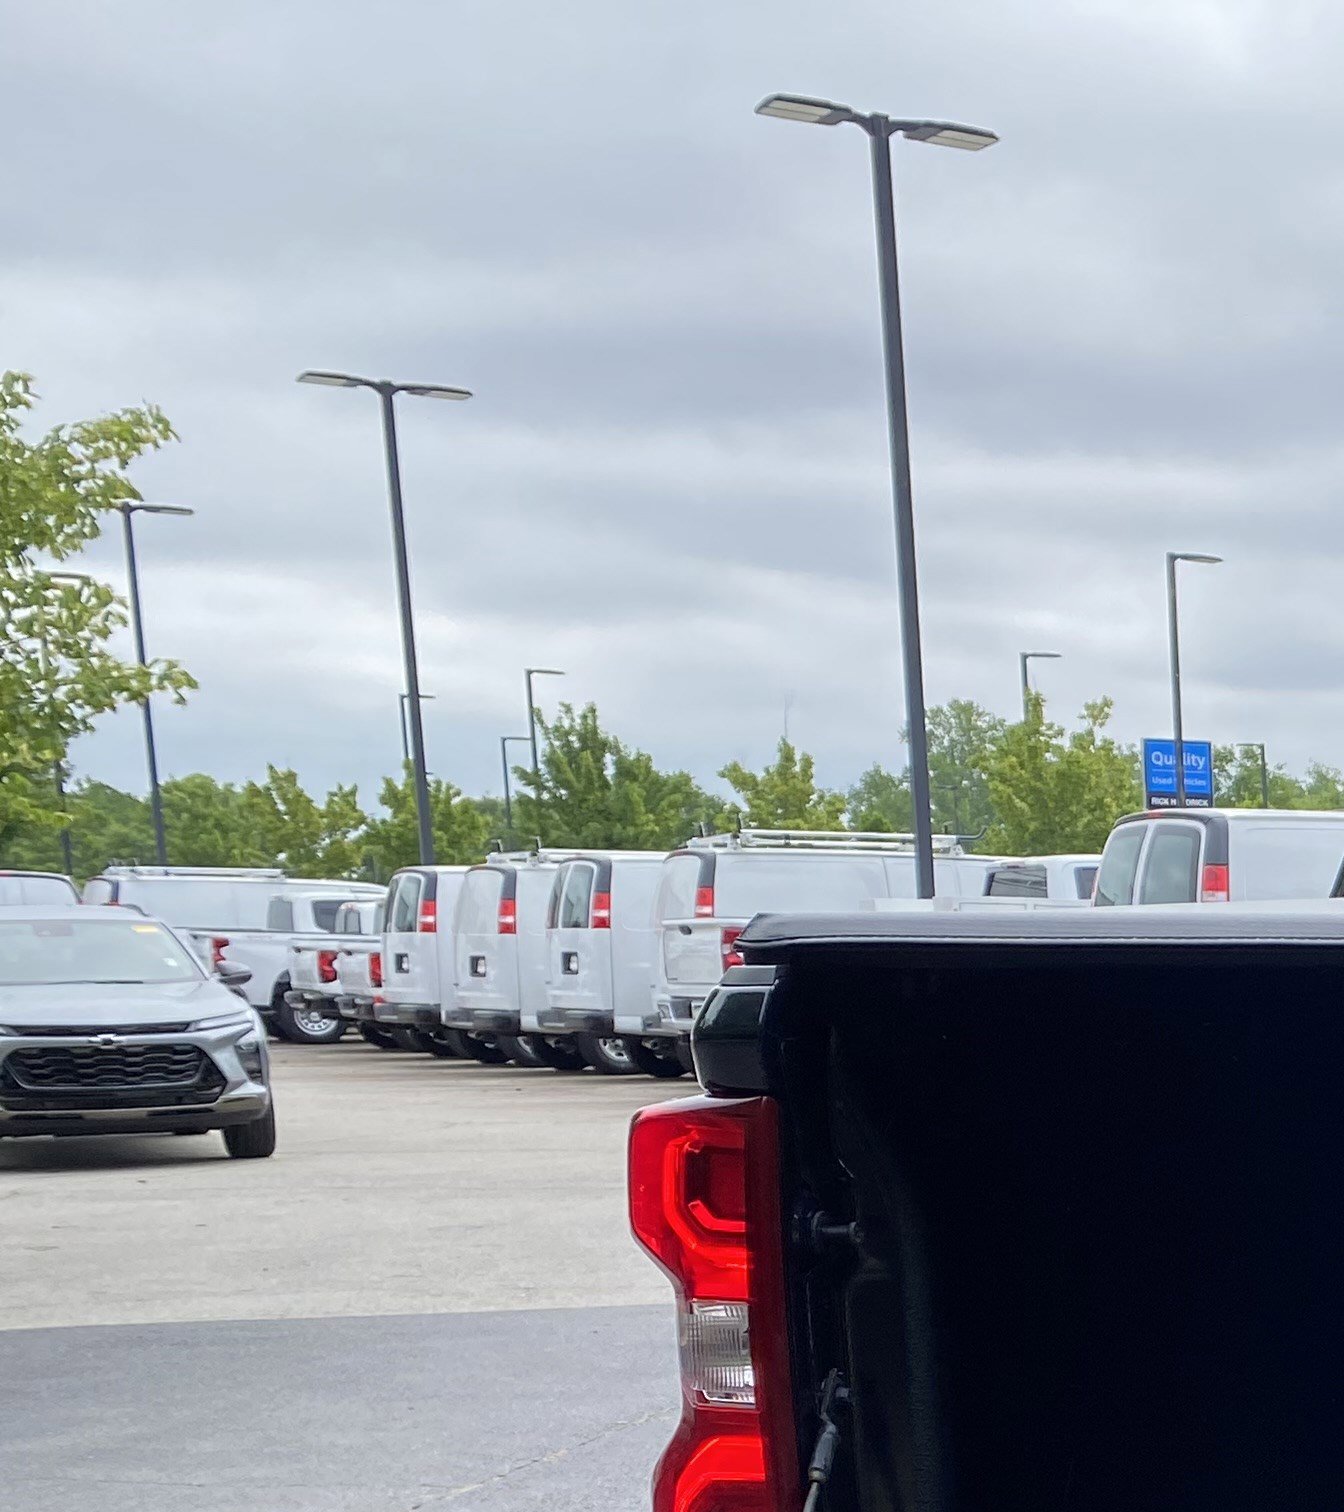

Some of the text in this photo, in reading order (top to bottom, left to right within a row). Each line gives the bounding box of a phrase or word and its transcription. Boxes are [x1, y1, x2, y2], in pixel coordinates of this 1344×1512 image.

[1151, 776, 1206, 786] Used hicles
[1170, 798, 1209, 807] HDRICK
